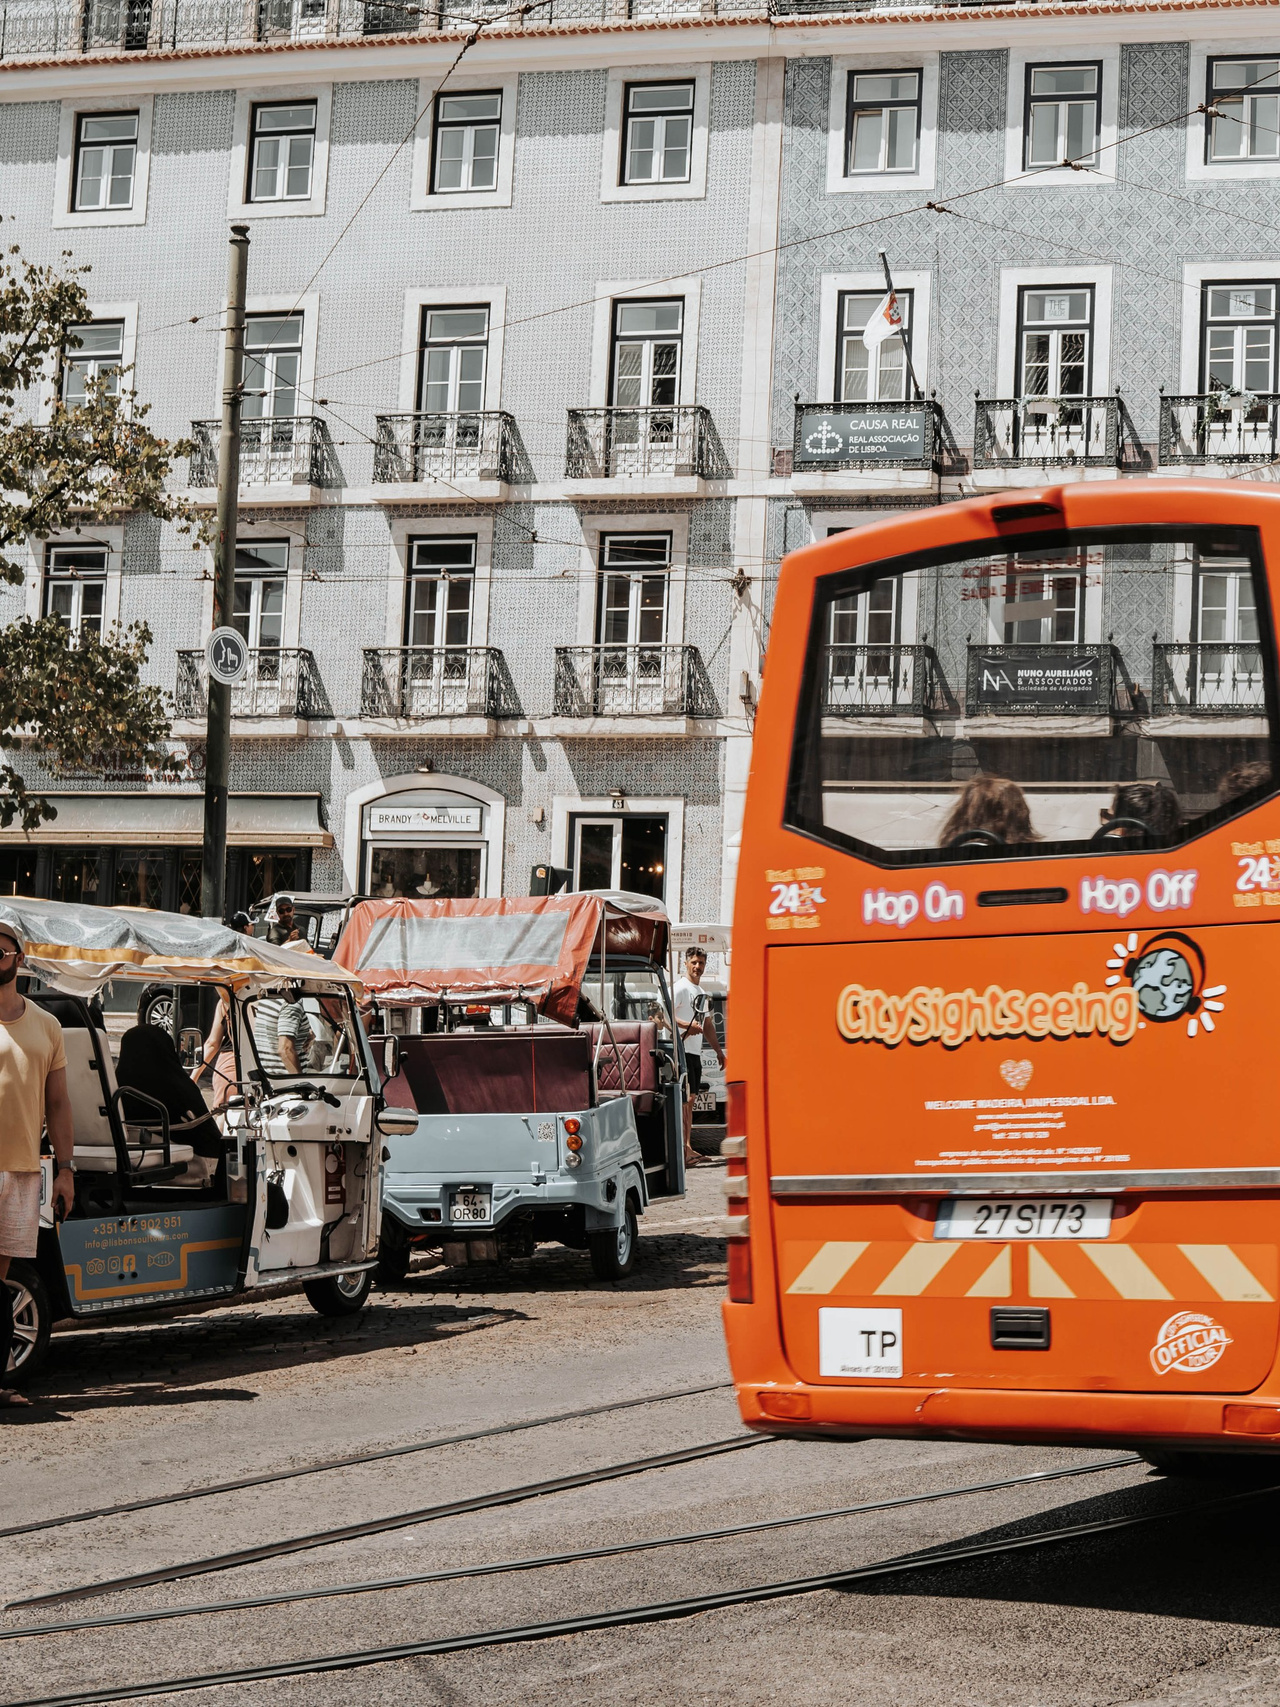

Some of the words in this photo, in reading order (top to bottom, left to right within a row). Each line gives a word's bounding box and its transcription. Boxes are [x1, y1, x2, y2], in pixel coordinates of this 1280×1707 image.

[1049, 299, 1066, 310] THE
[850, 420, 888, 430] CAUSA
[892, 418, 919, 429] REAL
[849, 436, 868, 444] REAL
[870, 434, 920, 444] ASSOCIAÇÃO
[848, 446, 860, 454] DE
[861, 446, 888, 454] LISBOA
[1017, 669, 1042, 678] NUNO
[1045, 669, 1093, 678] AURELIANO
[378, 814, 412, 824] BRANDY
[430, 815, 472, 824] MELVILLE
[1080, 876, 1140, 918] Hop
[1146, 871, 1198, 912] Off
[863, 889, 919, 928] Hop
[924, 882, 966, 920] On
[924, 1100, 976, 1110] WELCOME
[463, 1194, 477, 1206] 64
[92, 1222, 118, 1236] +351
[140, 1219, 161, 1230] 902
[164, 1216, 182, 1228] 951
[860, 1330, 896, 1358] TP
[1157, 1328, 1232, 1366] OFFICIAL
[1188, 1348, 1218, 1367] TOUR
